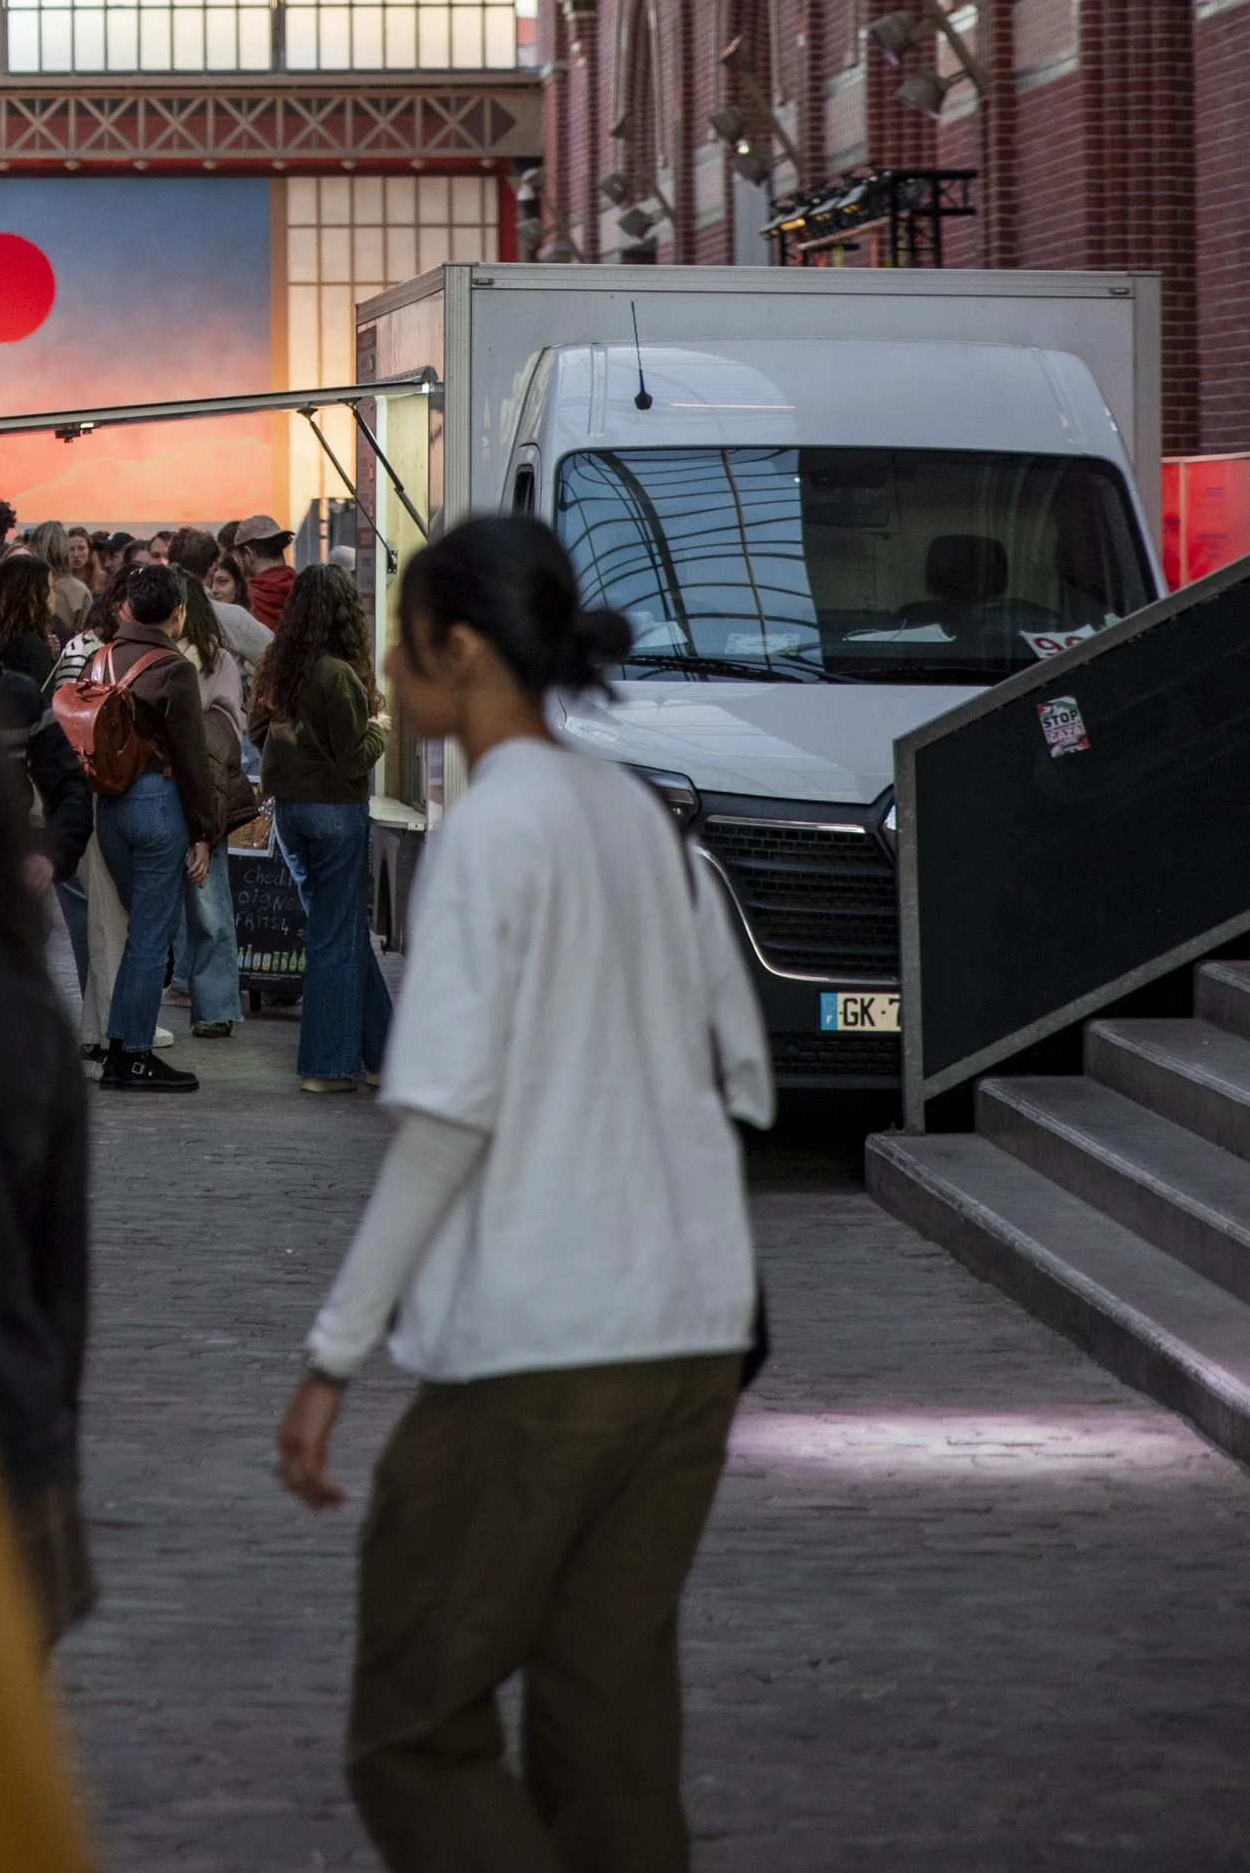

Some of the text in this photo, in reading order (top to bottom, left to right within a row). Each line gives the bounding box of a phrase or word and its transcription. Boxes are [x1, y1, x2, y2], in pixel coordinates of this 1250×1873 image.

[1043, 710, 1078, 729] STOP
[1048, 725, 1084, 743] GAZA
[843, 997, 901, 1027] GK-7
